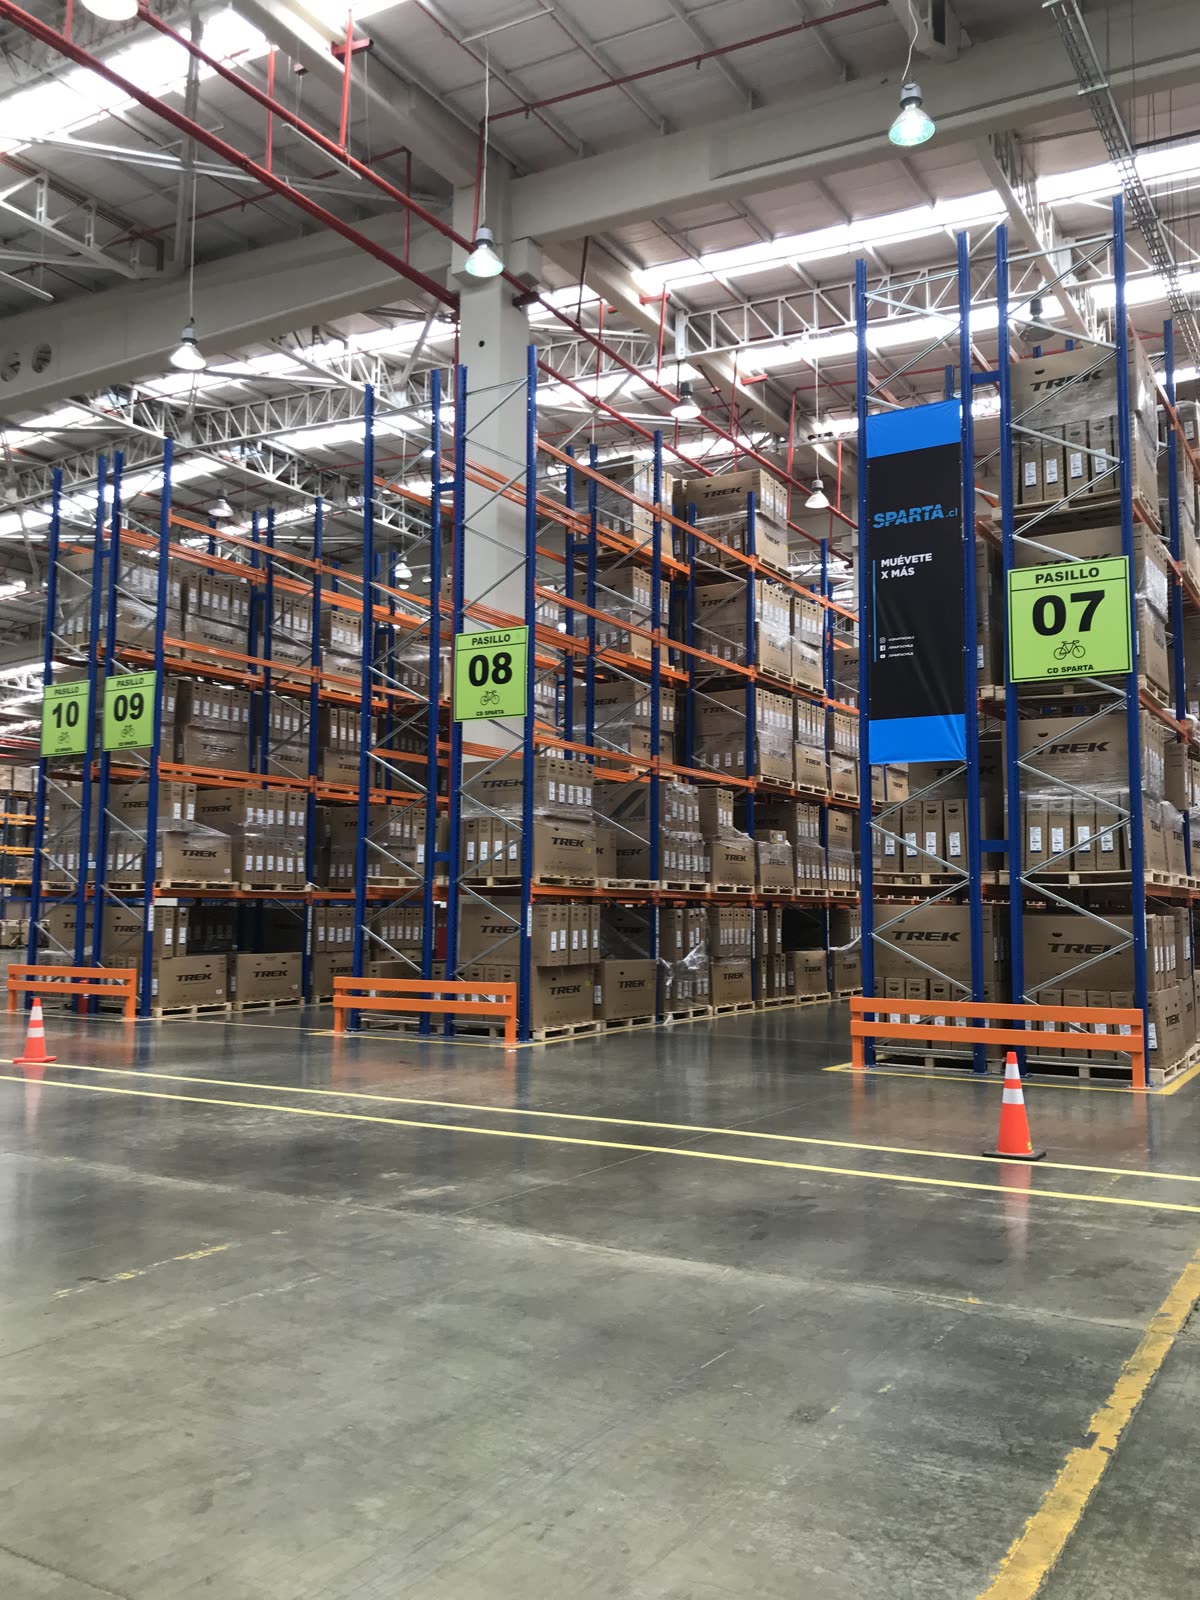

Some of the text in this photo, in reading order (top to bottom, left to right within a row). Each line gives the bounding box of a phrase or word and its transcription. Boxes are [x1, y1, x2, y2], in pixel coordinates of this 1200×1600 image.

[704, 487, 742, 498] TREK
[881, 553, 932, 568] MUÉVETE
[881, 566, 915, 580] X MÁS
[1035, 567, 1100, 584] PASILLO
[1032, 590, 1105, 636] 07
[472, 634, 511, 646] PASILLO
[468, 652, 512, 687] 08
[1061, 664, 1094, 673] SPARTA
[116, 678, 144, 687] PASILLO
[54, 686, 80, 696] PASILLO
[114, 692, 144, 722] 09
[702, 704, 740, 714] TREK
[52, 701, 79, 728] 10
[804, 758, 821, 766] TREK
[552, 836, 584, 848] TREK
[180, 850, 217, 858] TREK
[724, 854, 746, 862] TREK
[892, 930, 960, 942] TREK
[176, 973, 212, 982] TREK
[722, 972, 744, 980] TREK
[550, 984, 581, 995] TREK
[618, 980, 646, 988] TREK
